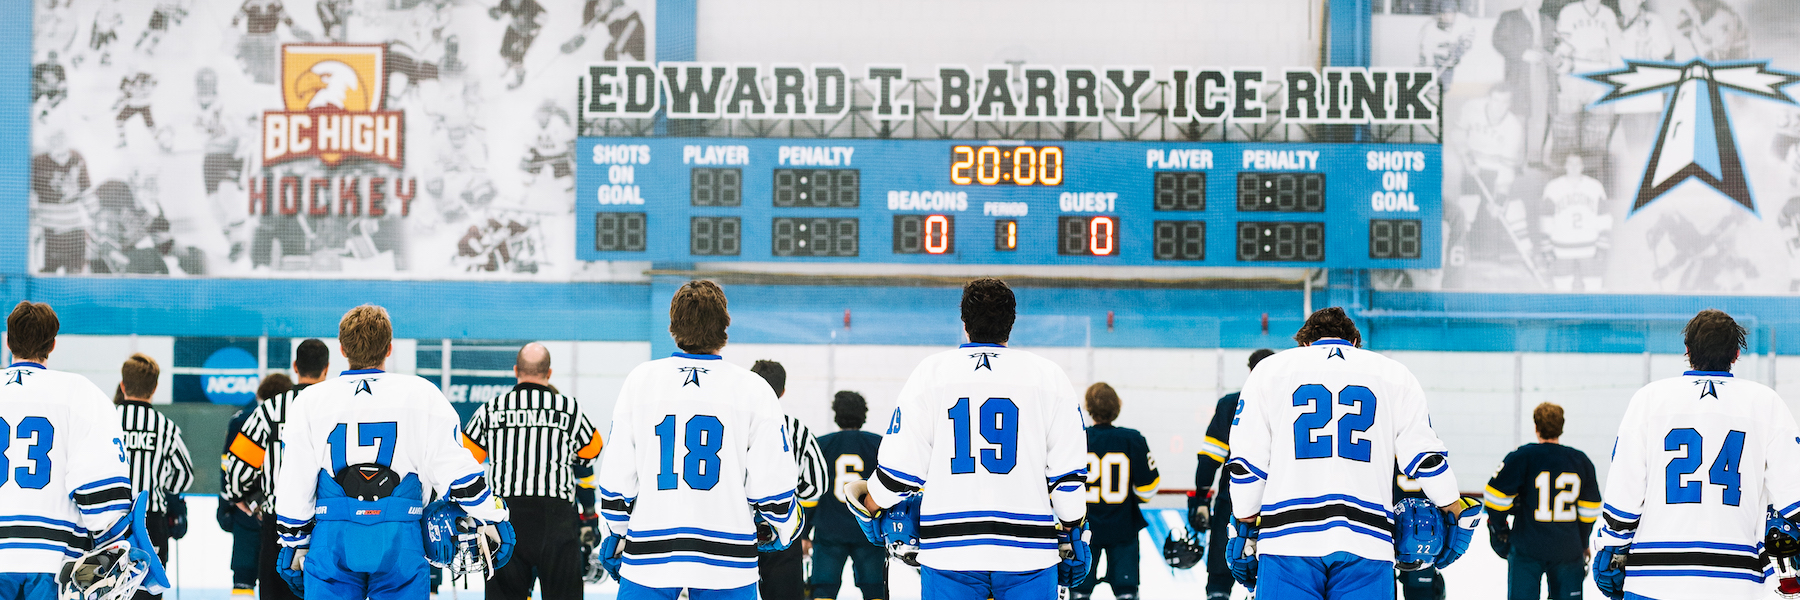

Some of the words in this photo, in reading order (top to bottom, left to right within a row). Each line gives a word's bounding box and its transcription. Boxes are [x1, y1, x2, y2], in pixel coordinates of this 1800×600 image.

[585, 62, 850, 119] EDWARD
[865, 64, 914, 120] T.
[935, 65, 1153, 121] BARRY
[1169, 66, 1266, 122] ICE
[1282, 66, 1438, 124] RINK
[264, 114, 311, 160] BC
[318, 114, 400, 161] HIGH
[592, 145, 651, 165] SHOTS
[683, 145, 749, 166] PLAYER
[778, 146, 854, 167] PENALTY
[951, 145, 1064, 186] 20:00
[1146, 149, 1214, 170] PLAYER
[1242, 150, 1320, 171] PENALTY
[1366, 151, 1425, 171] SHOTS
[608, 165, 634, 185] ON
[1382, 172, 1408, 192] ON
[248, 176, 417, 217] HOCKEY
[597, 185, 645, 206] GOAL
[887, 191, 968, 212] BEACONS
[1059, 191, 1118, 212] GUEST
[1371, 192, 1420, 212] GOAL
[924, 215, 949, 255] 0
[1007, 221, 1017, 249] 1
[1090, 216, 1114, 256] 0
[207, 376, 258, 394] NCAA
[449, 384, 469, 403] CE
[487, 409, 570, 431] McDONALD
[886, 407, 902, 434] 19
[1232, 399, 1245, 426] 2
[1292, 384, 1377, 463] 22
[122, 431, 156, 450] OOKE
[780, 424, 792, 453] 1
[948, 397, 1019, 475] 19
[112, 437, 130, 465] 3
[326, 421, 398, 479] 17
[655, 414, 725, 491] 18
[834, 454, 864, 503] 6
[1086, 452, 1131, 504] 20
[1664, 428, 1747, 507] 24
[1534, 471, 1581, 523] 12
[1766, 510, 1779, 520] 24
[892, 522, 904, 533] 19
[1416, 544, 1431, 554] 22
